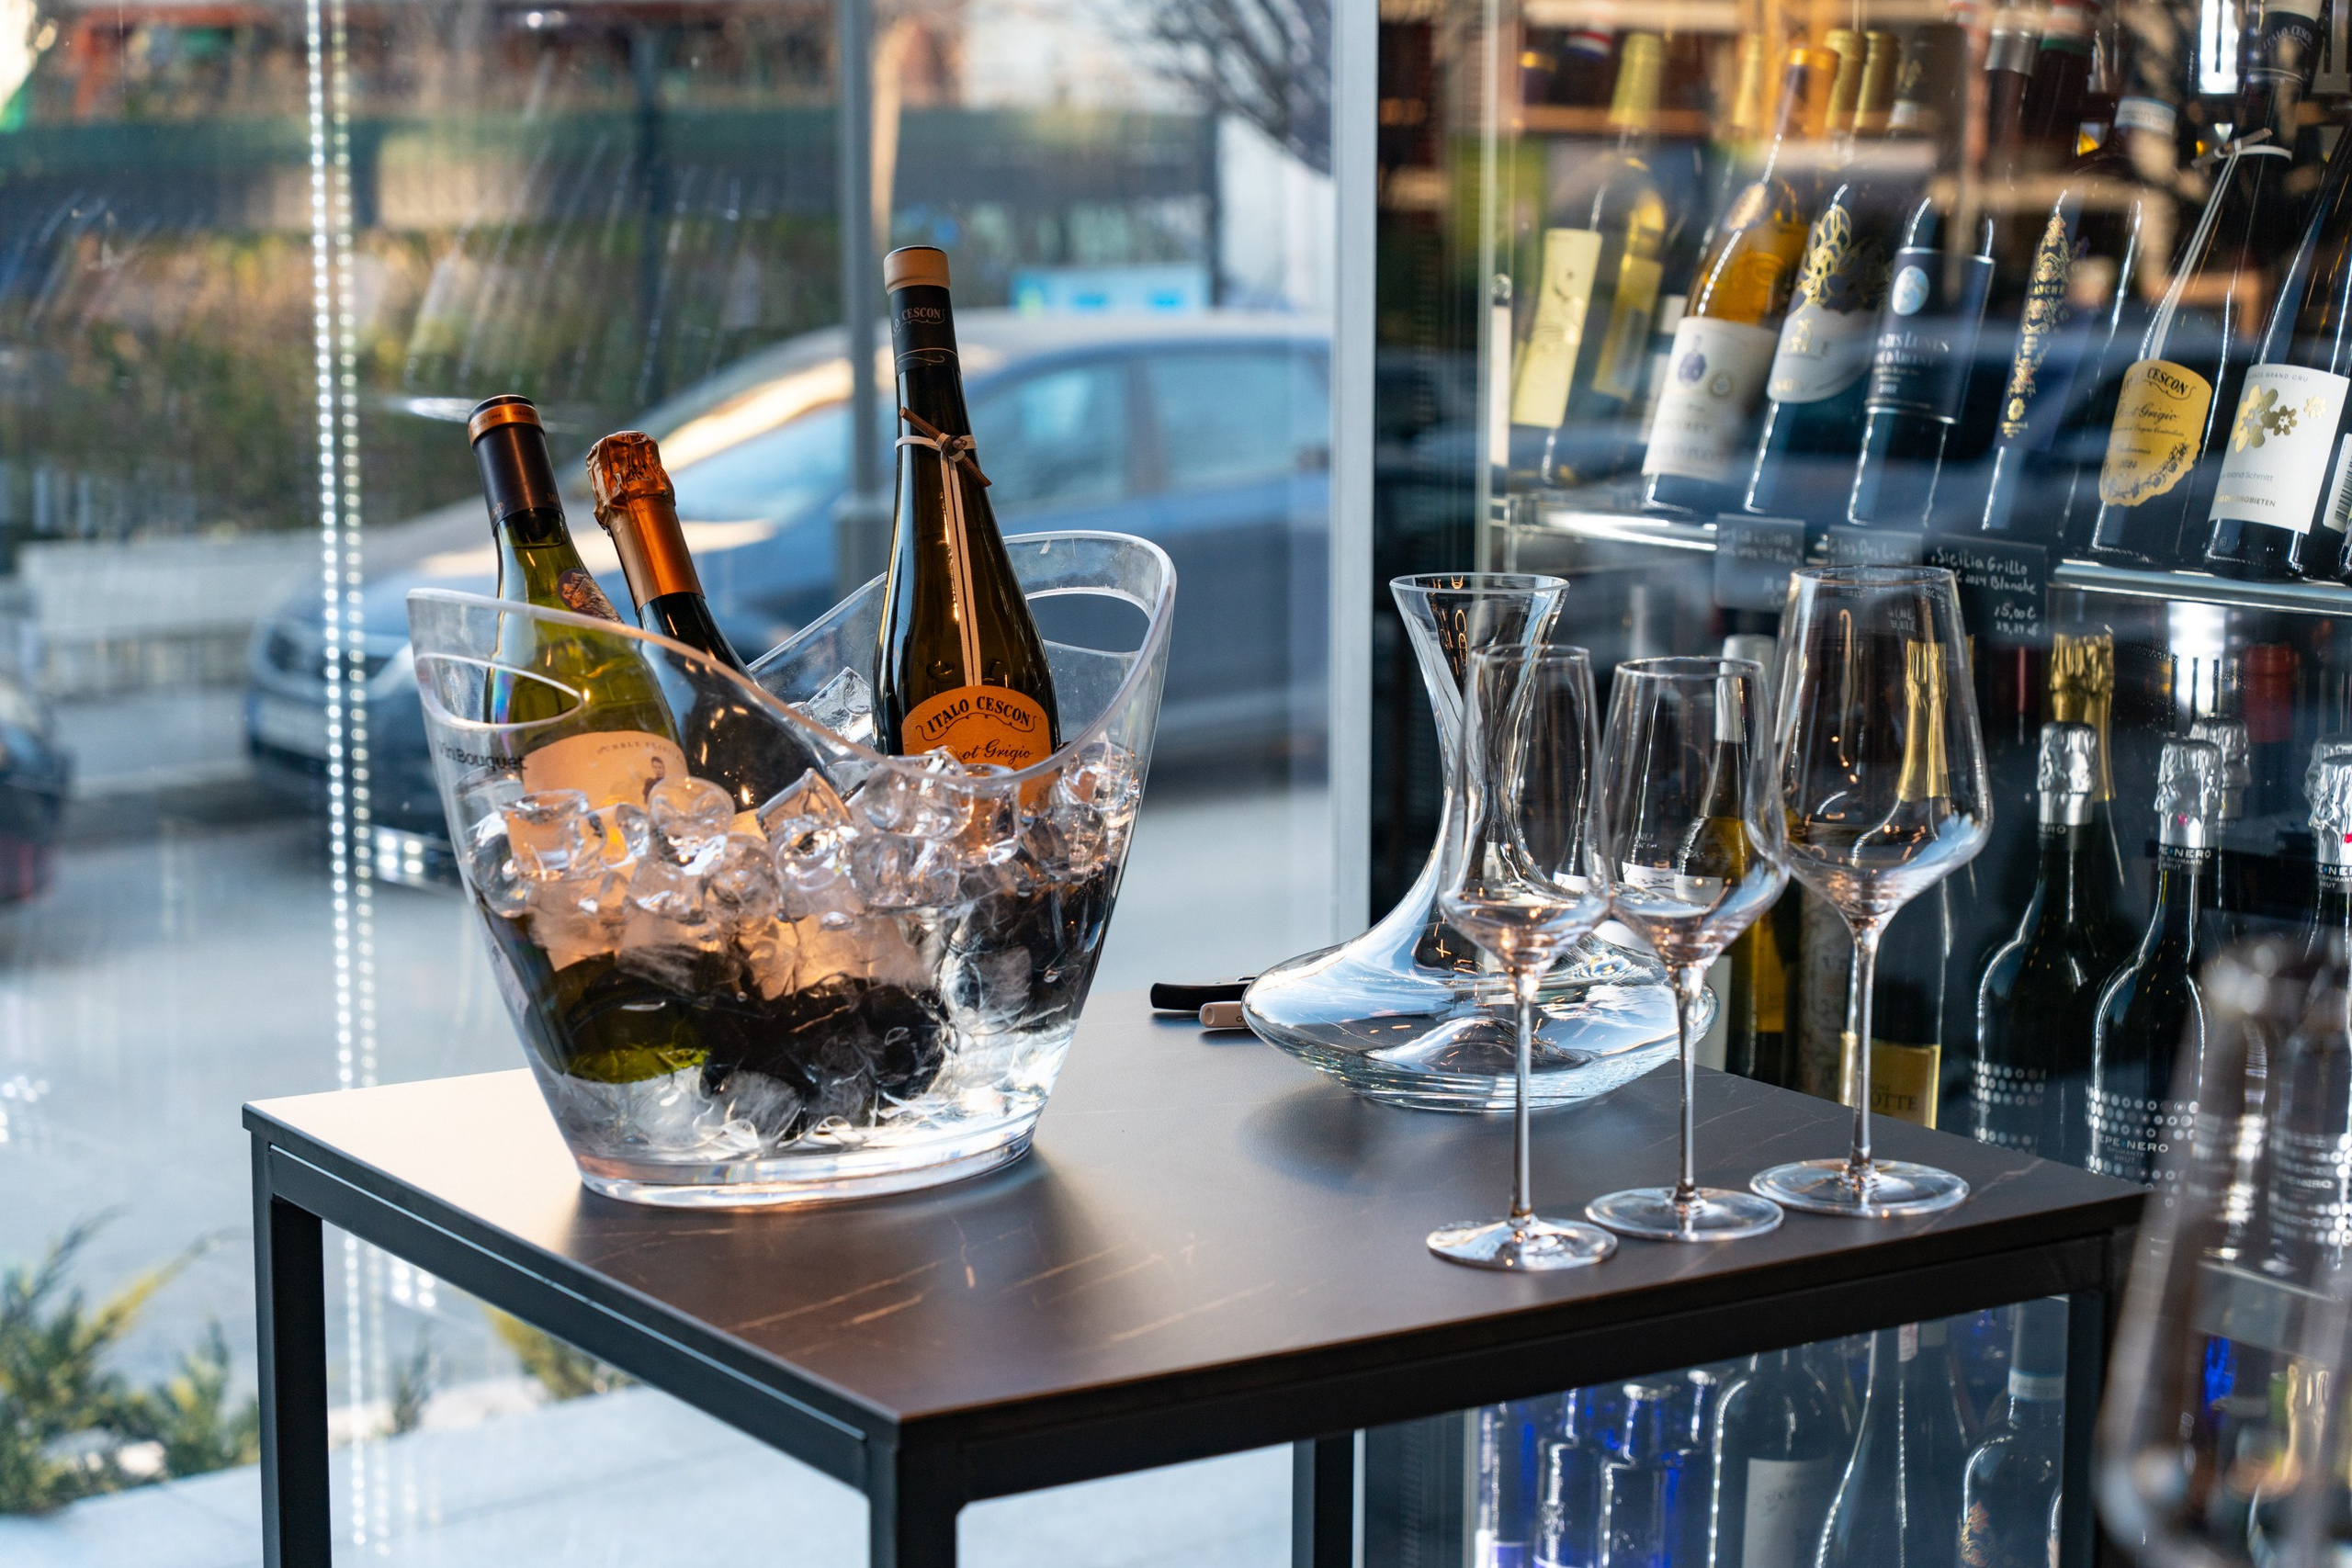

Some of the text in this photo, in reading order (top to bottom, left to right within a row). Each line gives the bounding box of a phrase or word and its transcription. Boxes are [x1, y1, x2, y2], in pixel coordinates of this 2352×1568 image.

[2147, 366, 2189, 397] CESCON
[2291, 375, 2309, 383] CRU
[927, 695, 1031, 733] ITALO CESCON
[436, 739, 527, 772] VinBouquet
[983, 739, 1035, 765] Grigio
